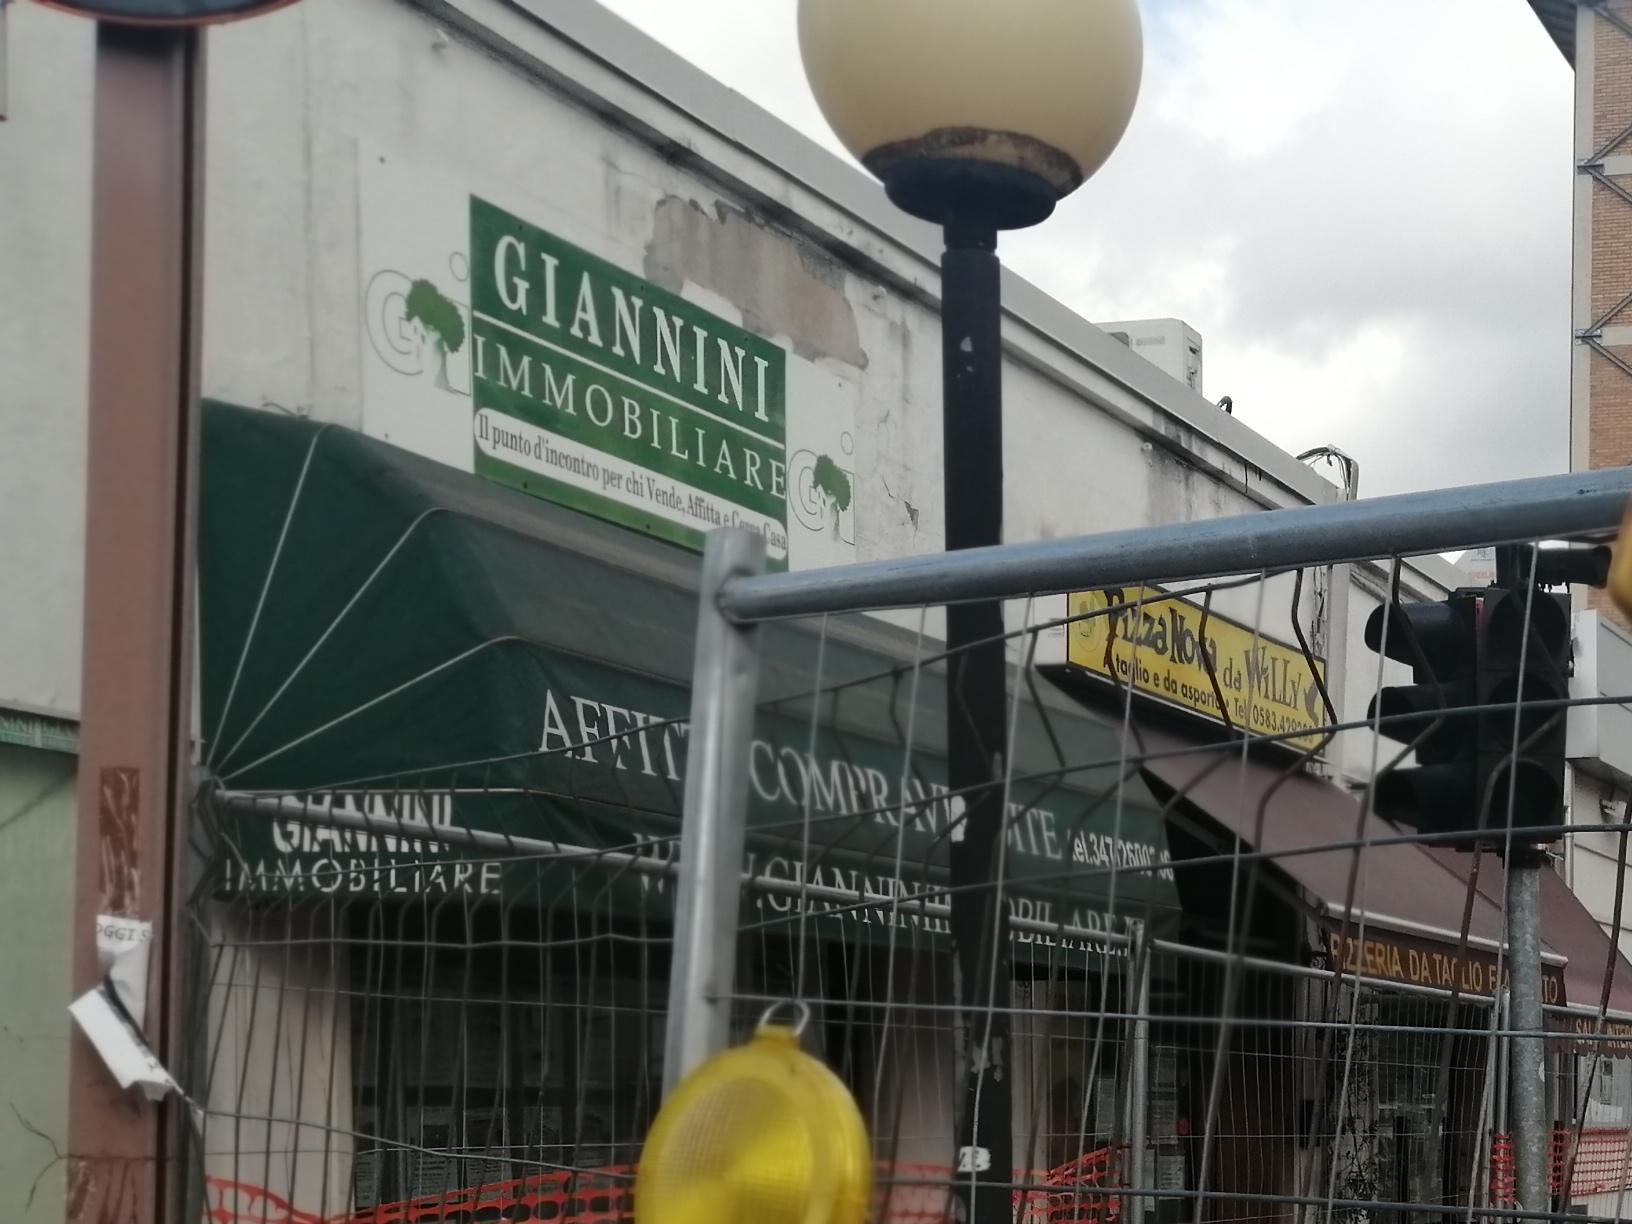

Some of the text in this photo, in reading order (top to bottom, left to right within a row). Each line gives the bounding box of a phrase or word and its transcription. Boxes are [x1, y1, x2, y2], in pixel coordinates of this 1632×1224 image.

[494, 235, 769, 423] GIANNINI
[474, 336, 787, 498] IMMOBILIARE
[479, 414, 489, 440] Il
[492, 426, 531, 457] punto
[534, 434, 599, 481] d'incontro
[602, 467, 622, 490] per
[626, 471, 644, 498] chi
[762, 522, 787, 551] Casa
[1153, 673, 1160, 688] e
[1164, 669, 1178, 694] da
[1223, 657, 1242, 692] da
[225, 858, 502, 895] IMMOBILIARE
[1330, 933, 1405, 979] PZZERIA
[1409, 949, 1432, 985] DA
